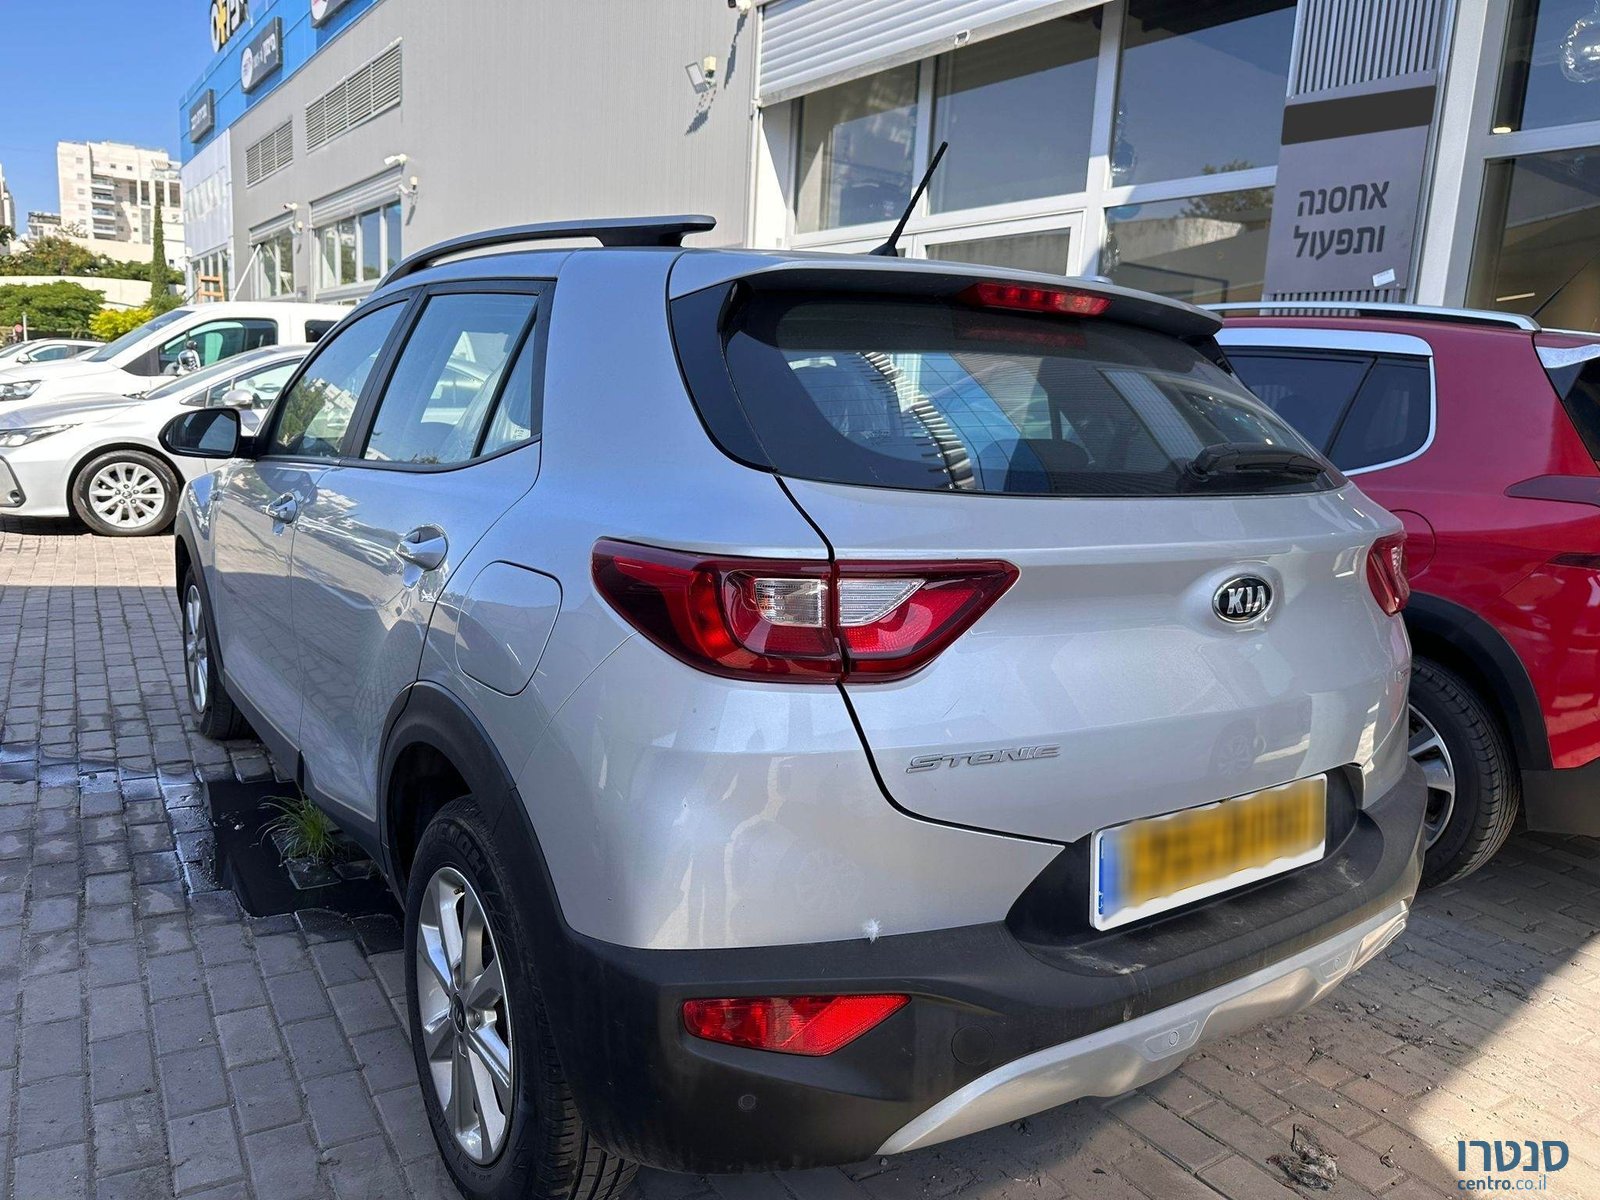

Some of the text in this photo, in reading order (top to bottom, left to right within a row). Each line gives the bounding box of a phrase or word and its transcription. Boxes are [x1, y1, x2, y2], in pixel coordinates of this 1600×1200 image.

[1297, 181, 1390, 217] אחסנה
[1293, 225, 1386, 261] ותפעול
[1226, 585, 1267, 615] KIA
[906, 743, 1061, 774] STONIC
